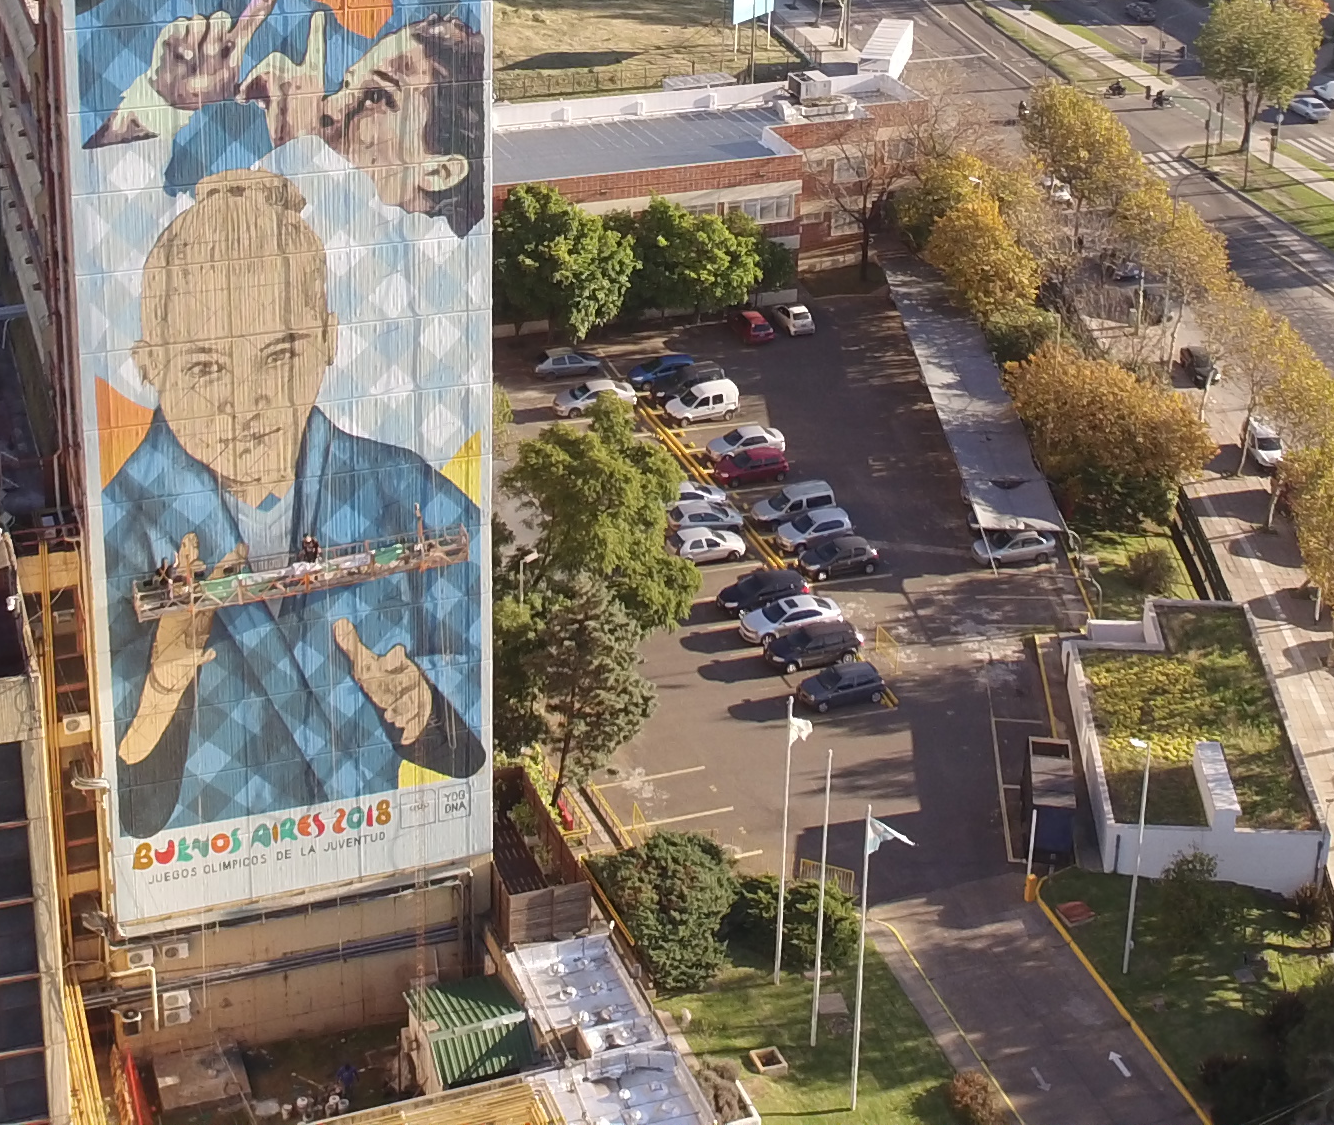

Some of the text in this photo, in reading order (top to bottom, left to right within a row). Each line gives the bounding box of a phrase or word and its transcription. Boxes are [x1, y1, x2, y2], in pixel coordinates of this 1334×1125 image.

[444, 801, 467, 814] DNA
[132, 799, 392, 870] BUENOS AIRES 2018
[148, 831, 386, 884] JUEGOS OLIMPICOS DE LA JUVENTUD
